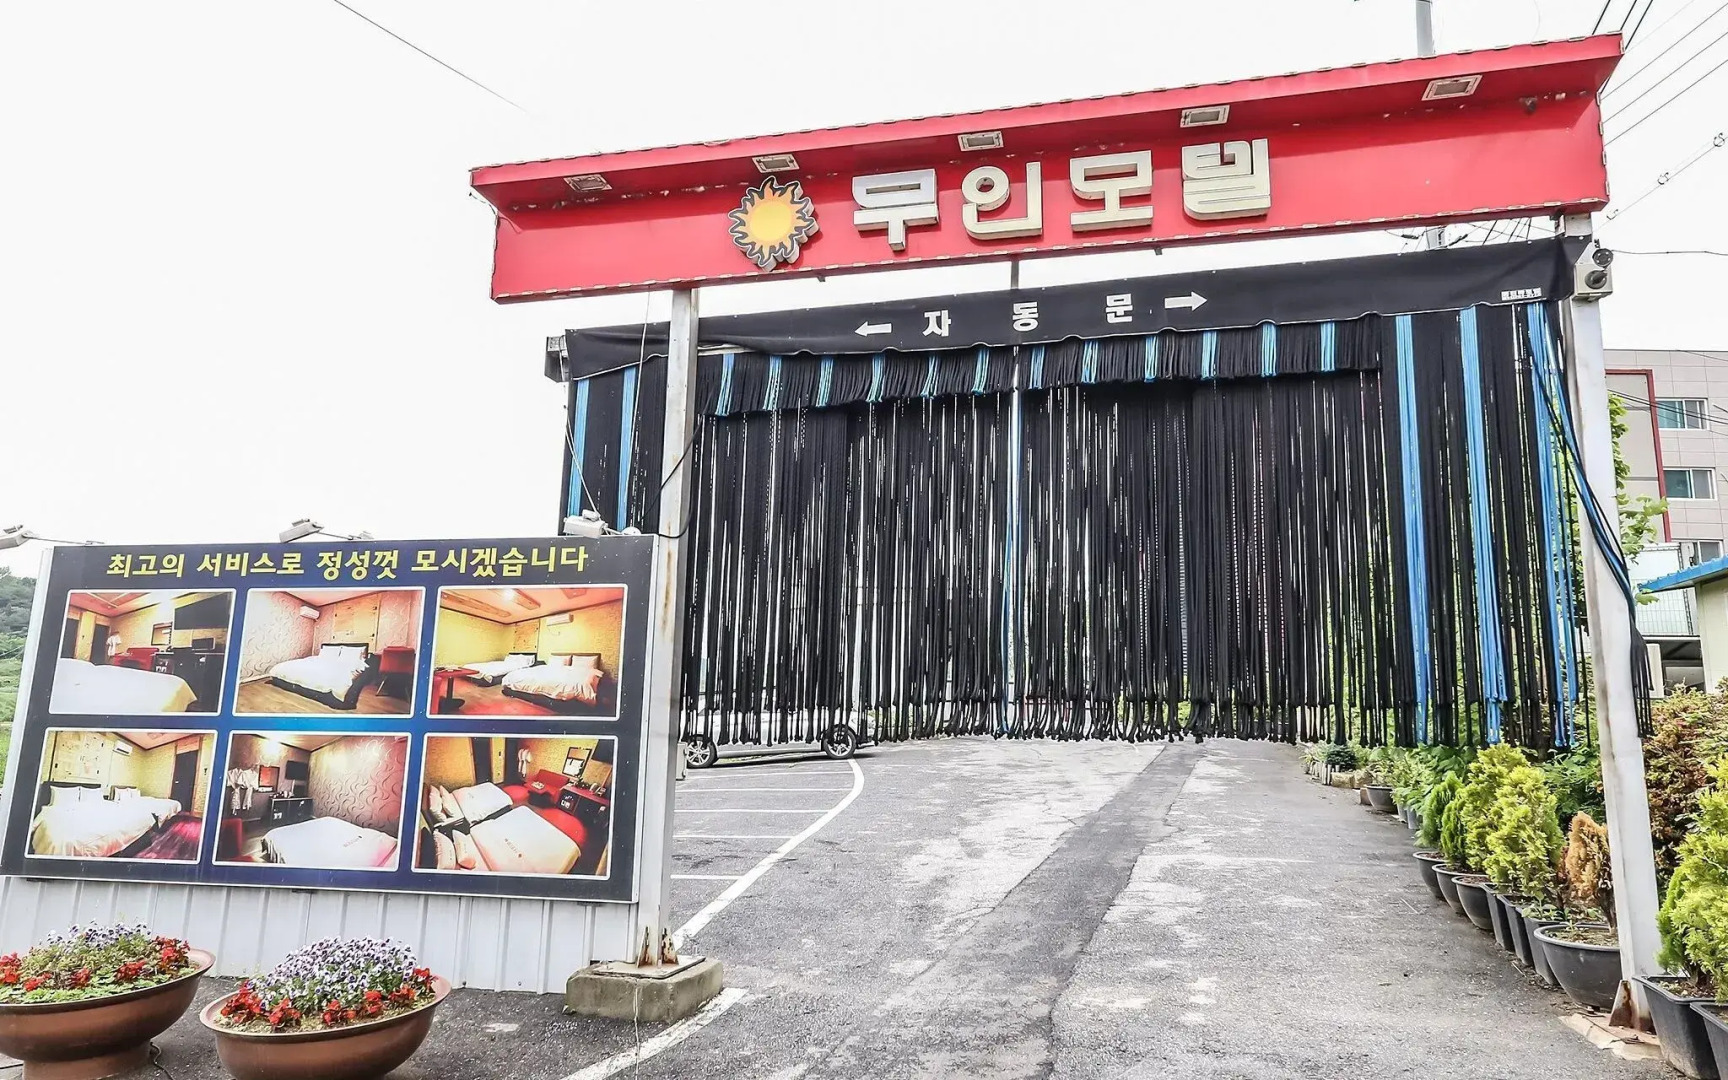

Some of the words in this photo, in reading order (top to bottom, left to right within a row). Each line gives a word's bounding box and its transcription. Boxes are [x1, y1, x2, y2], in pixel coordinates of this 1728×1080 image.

[852, 138, 1271, 251] 무인모텔
[106, 553, 185, 579] 최고의
[196, 552, 305, 578] 서비스로
[316, 550, 399, 581] 정성껏
[411, 546, 589, 578] 모시겠습니다
